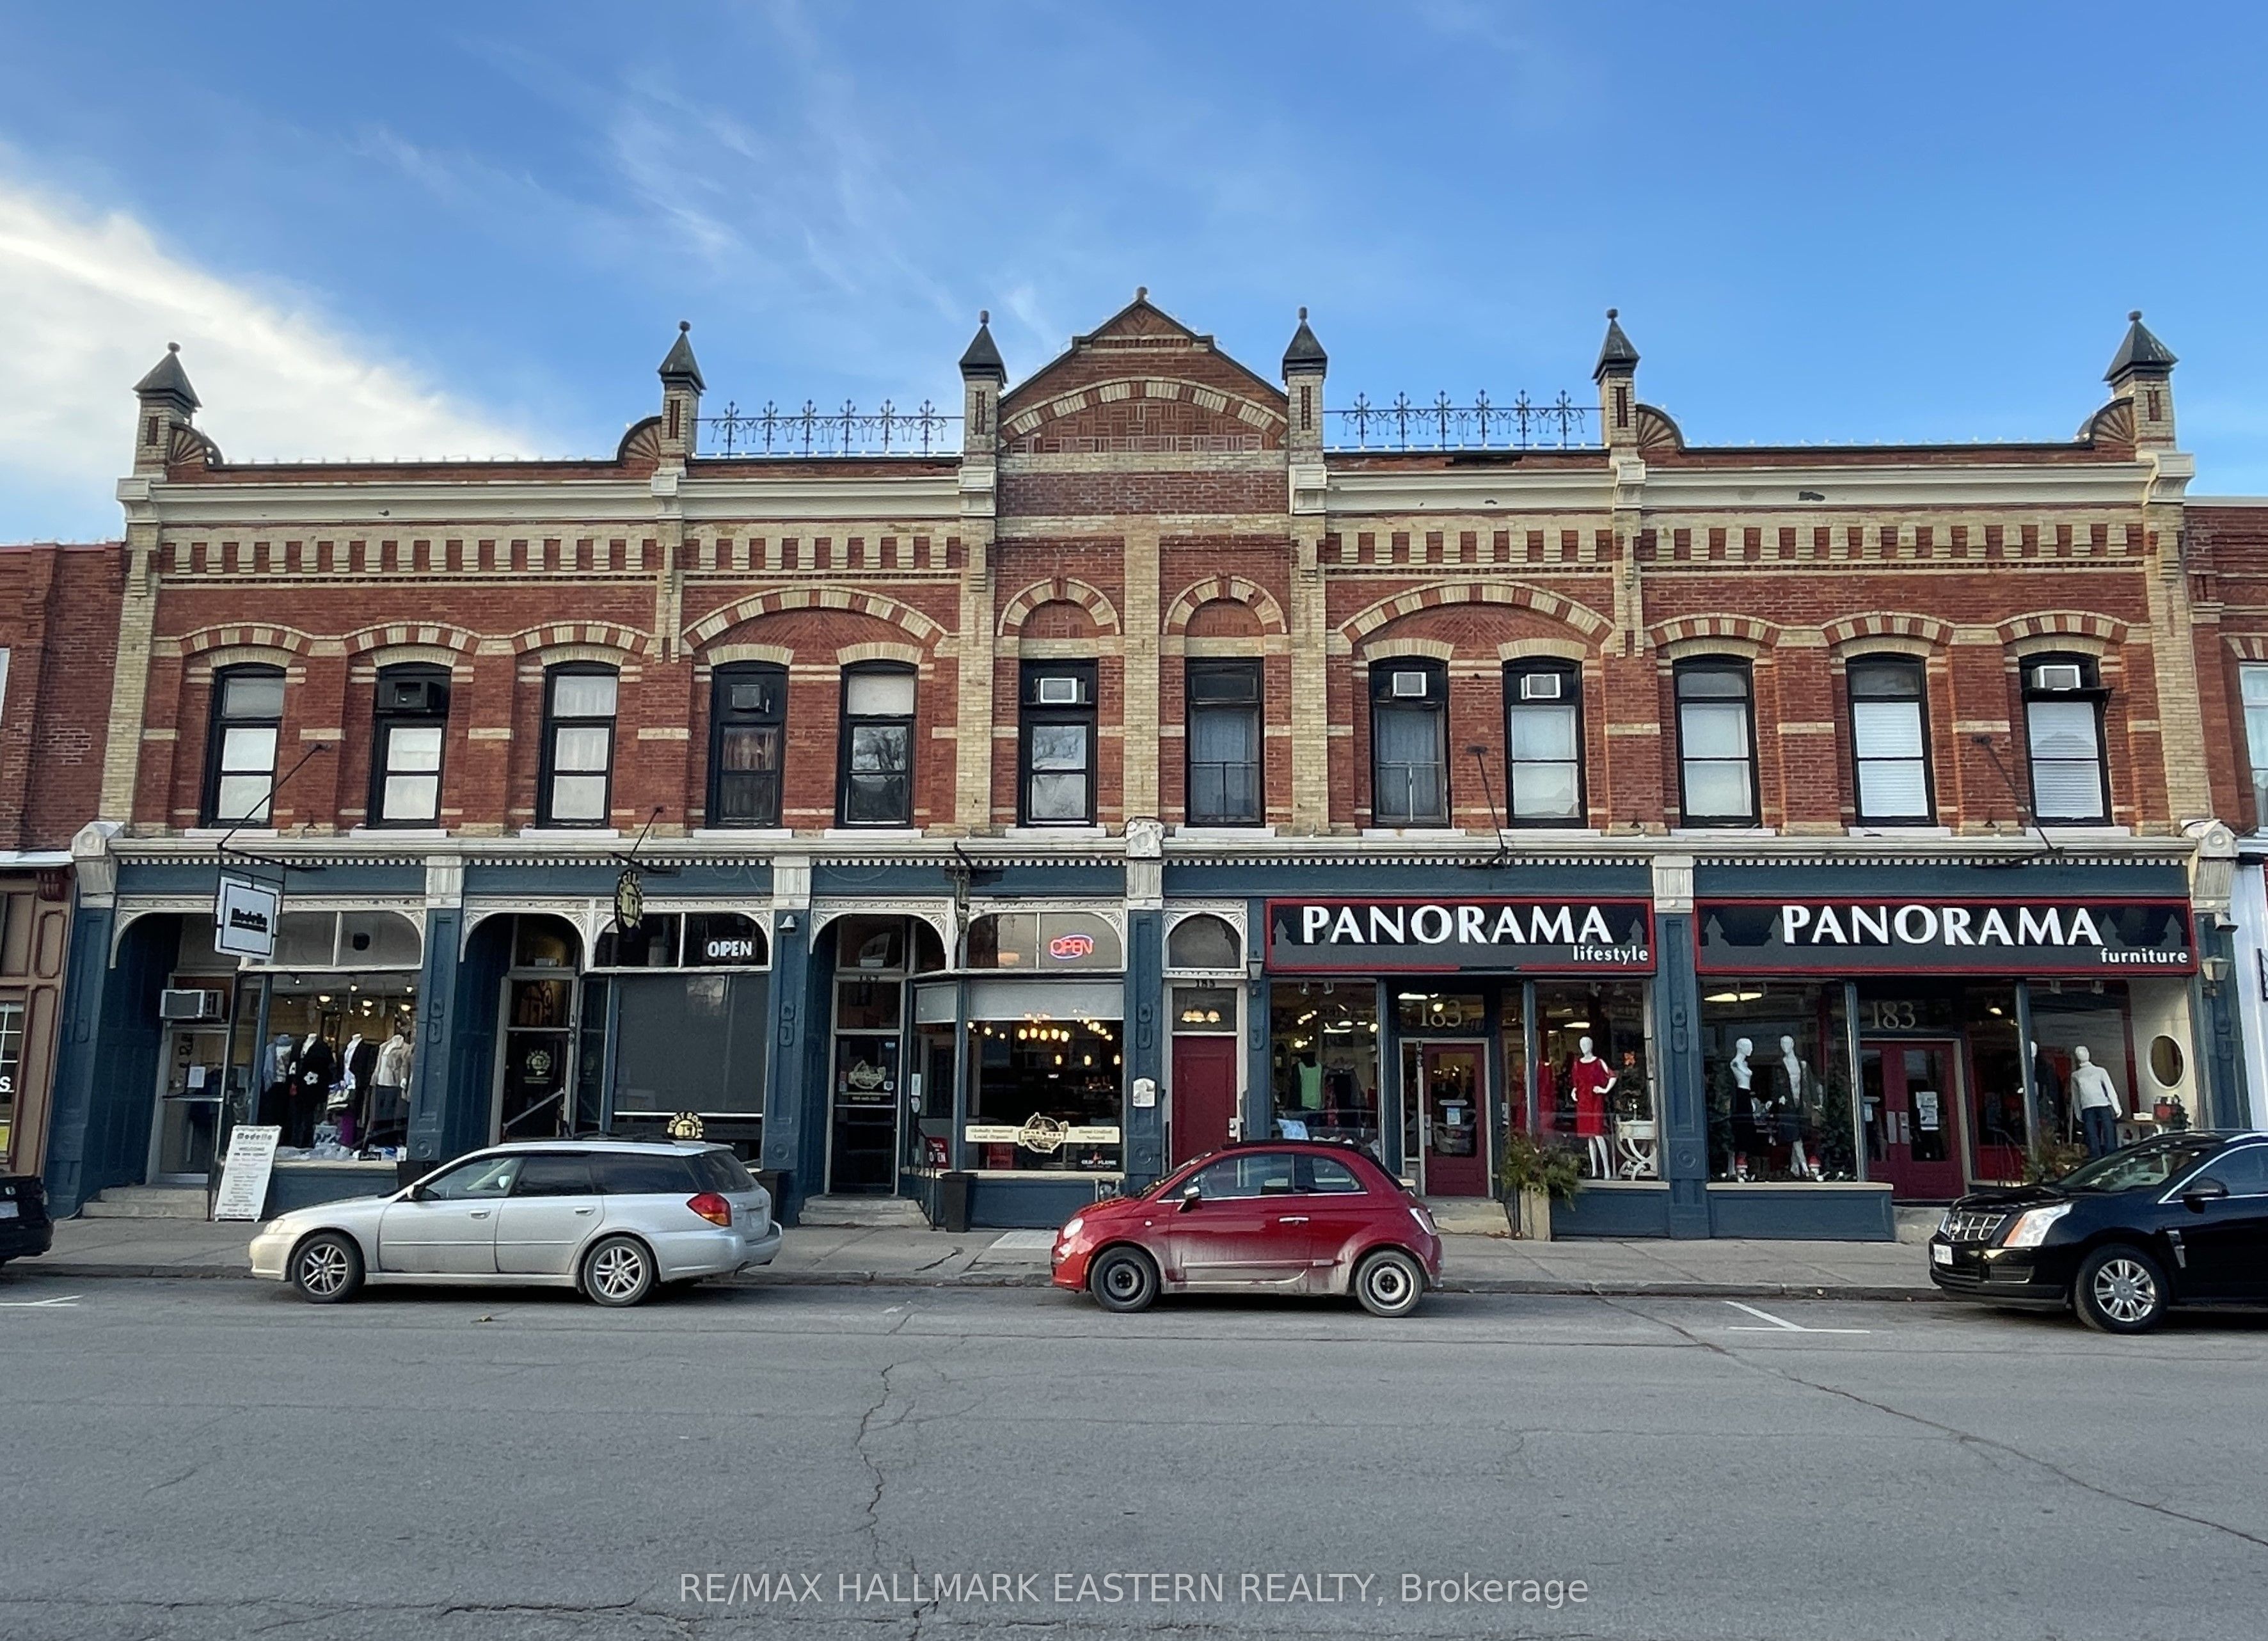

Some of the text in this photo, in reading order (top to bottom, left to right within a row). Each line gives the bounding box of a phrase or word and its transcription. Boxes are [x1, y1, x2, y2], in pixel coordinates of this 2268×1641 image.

[1303, 905, 1614, 944] PANORAMA
[1782, 904, 2104, 946] PANORAMA
[707, 940, 752, 958] OPEN
[1050, 939, 1093, 955] OPEN
[1573, 945, 1648, 965] lifestyle
[2100, 947, 2187, 963] furniture
[1871, 1001, 1916, 1029] 183
